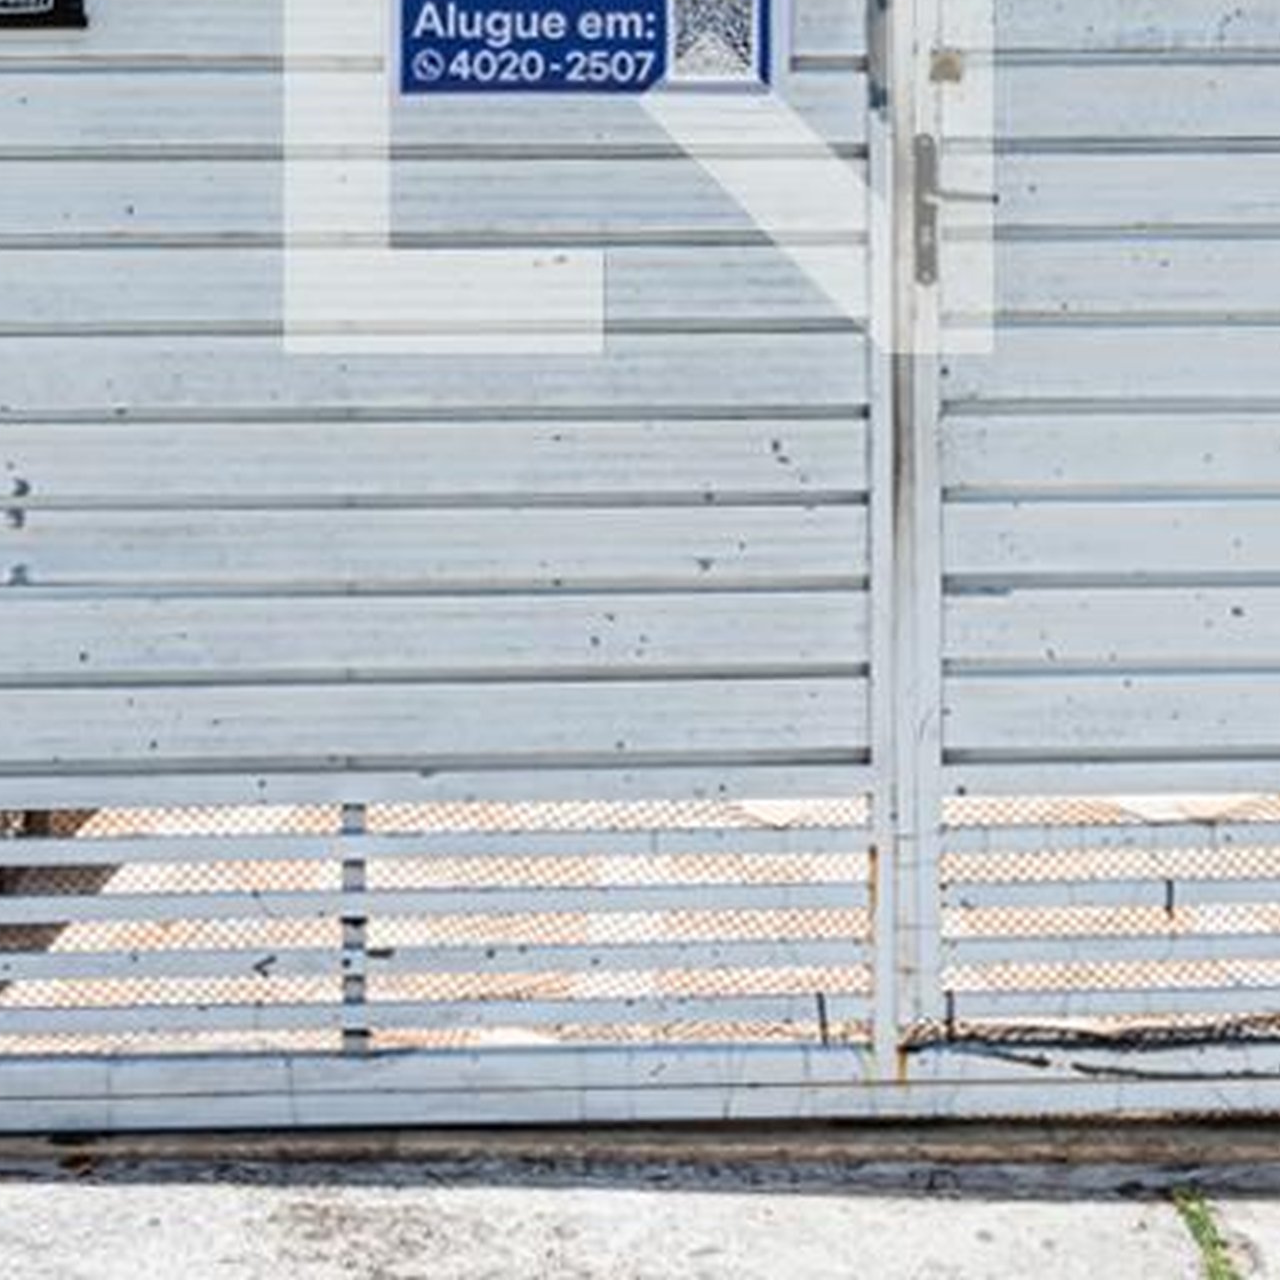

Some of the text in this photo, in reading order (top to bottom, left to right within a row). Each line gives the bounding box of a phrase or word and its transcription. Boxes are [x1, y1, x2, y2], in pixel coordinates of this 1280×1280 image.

[412, 2, 656, 48] Alugue em:
[449, 51, 656, 82] 4020-2507
